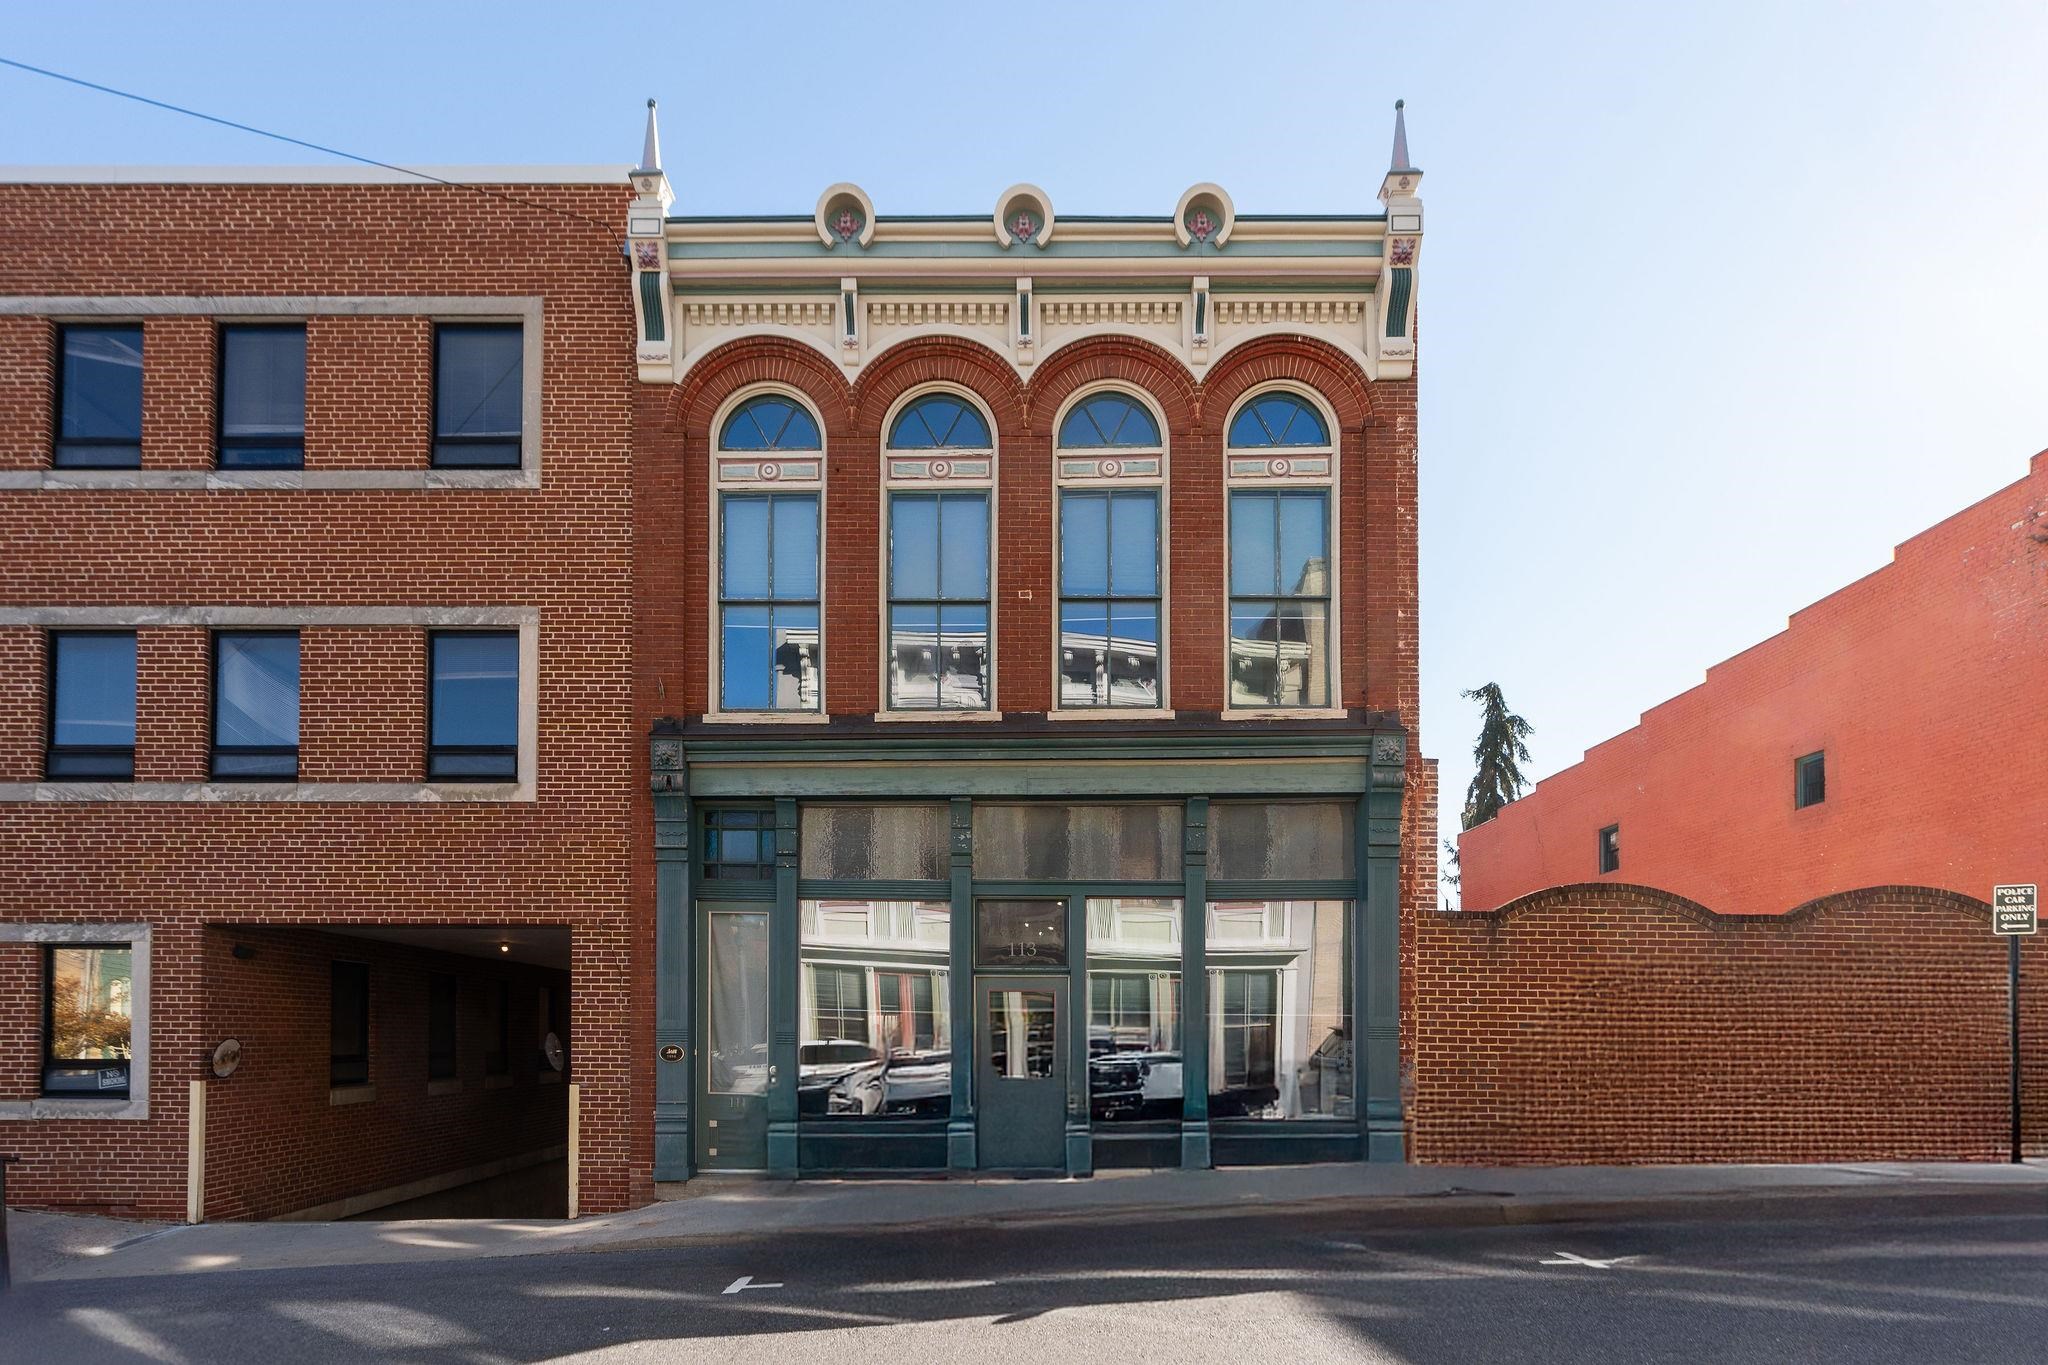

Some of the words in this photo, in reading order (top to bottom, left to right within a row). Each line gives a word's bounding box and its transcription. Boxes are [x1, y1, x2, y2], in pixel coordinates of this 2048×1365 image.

[1997, 888, 2034, 896] POLICE
[2004, 896, 2026, 904] CAR
[1996, 904, 2035, 912] PARKING
[2000, 913, 2030, 921] ONLY
[1008, 942, 1037, 957] 113
[106, 1069, 120, 1078] NO
